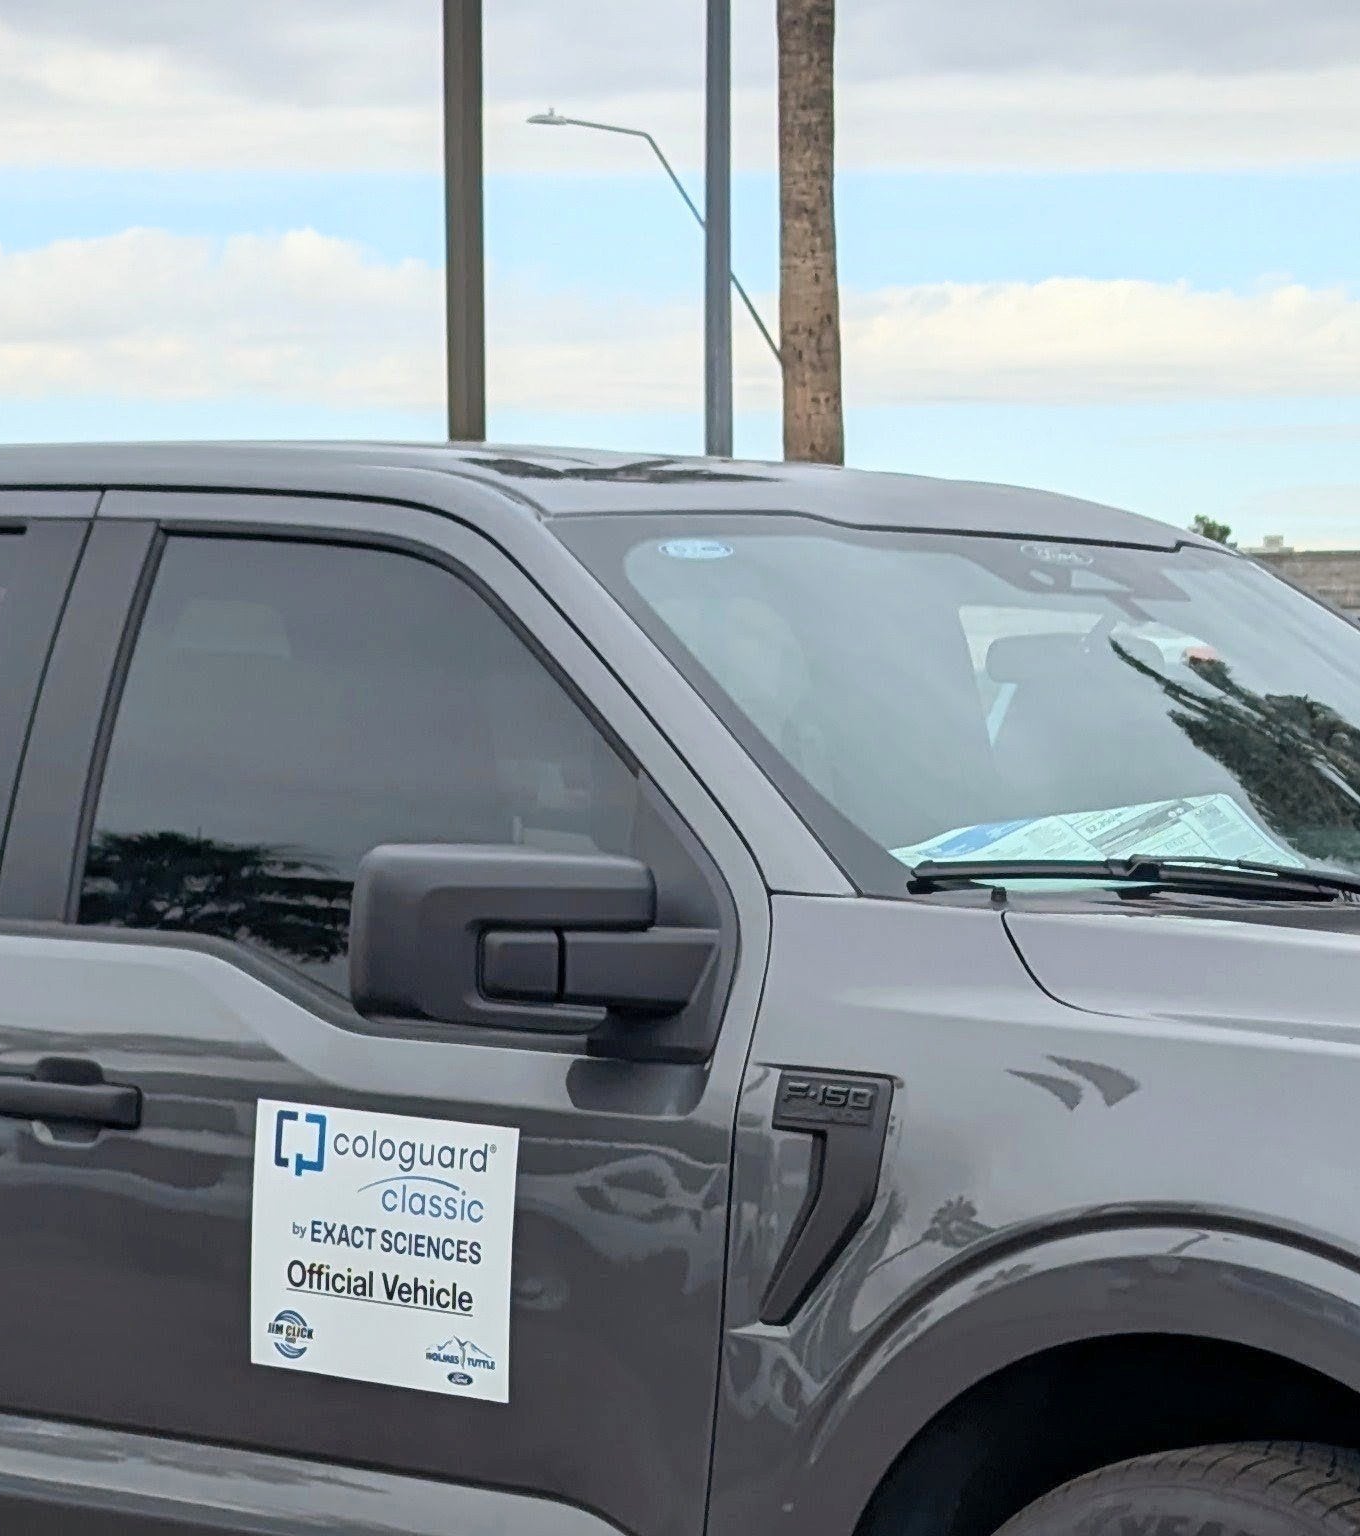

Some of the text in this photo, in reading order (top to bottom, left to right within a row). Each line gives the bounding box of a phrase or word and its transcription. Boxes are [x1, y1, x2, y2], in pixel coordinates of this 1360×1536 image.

[381, 1184, 484, 1223] classic
[292, 1220, 482, 1265] by EXACT SCIENCES
[287, 1259, 473, 1312] Official Vehicle
[286, 1325, 313, 1340] CLICK
